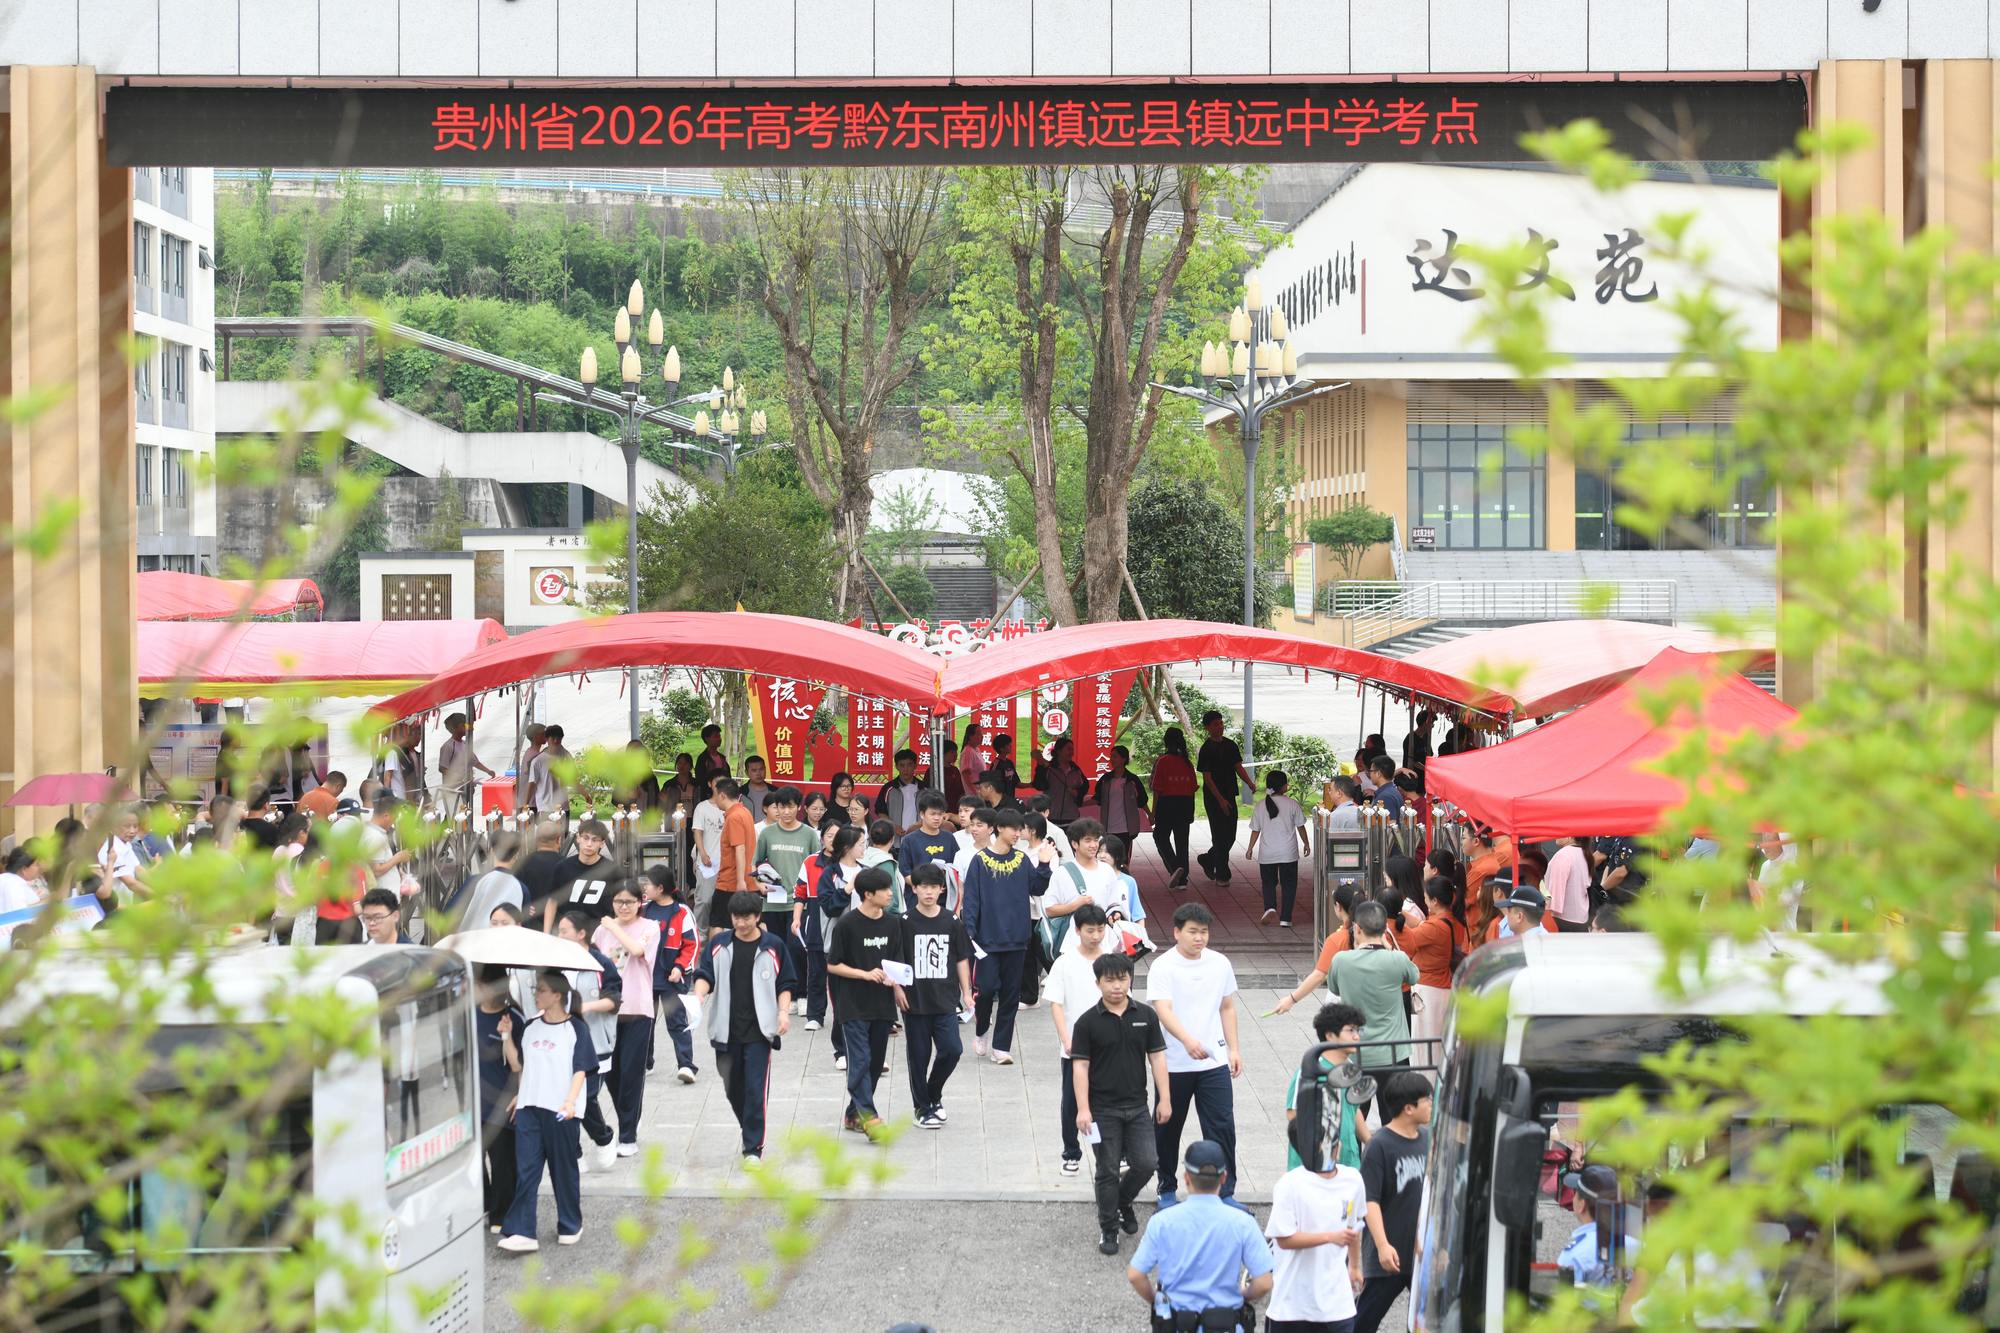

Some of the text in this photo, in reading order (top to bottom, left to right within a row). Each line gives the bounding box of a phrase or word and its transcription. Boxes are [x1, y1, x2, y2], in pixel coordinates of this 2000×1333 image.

[432, 97, 1479, 152] 贵州省2026年高考黔东南州镇远县镇远中学考点
[768, 677, 814, 721] 核心
[856, 715, 885, 729] 民主
[773, 726, 794, 776] 价值观
[856, 733, 885, 749] 文明
[856, 751, 885, 767] 和谐
